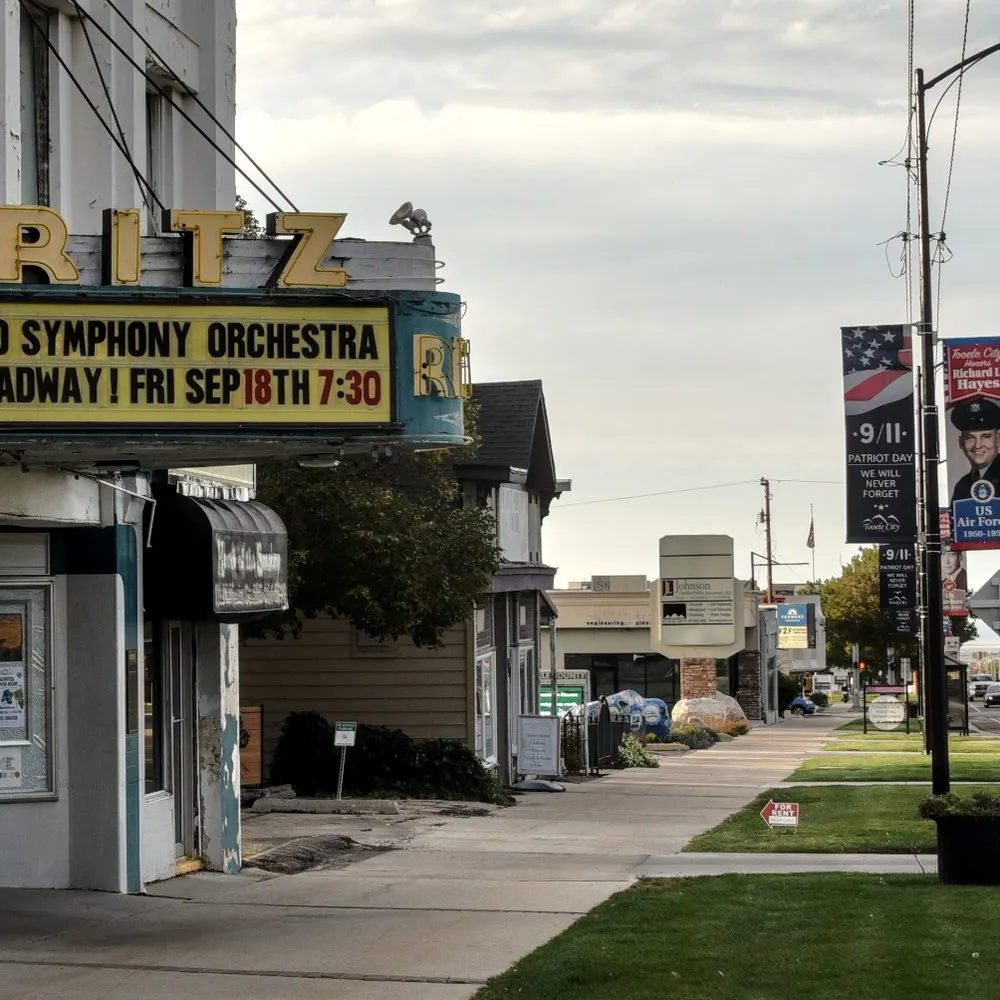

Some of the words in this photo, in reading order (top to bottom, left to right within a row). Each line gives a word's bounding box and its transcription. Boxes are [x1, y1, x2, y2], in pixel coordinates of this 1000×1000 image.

[21, 320, 190, 358] SYMPHONY
[207, 322, 379, 361] ORCHESTRA
[952, 348, 980, 359] Tooele
[952, 368, 992, 379] Richard
[130, 368, 174, 404] FRI
[318, 369, 381, 406] 7:30
[957, 379, 1000, 391] Hayes
[859, 422, 901, 444] 9/11
[848, 454, 890, 463] PATRIOT
[892, 453, 913, 462] DAY
[878, 469, 900, 477] WILL
[863, 490, 899, 498] FORGET
[975, 506, 993, 516] US
[957, 517, 975, 527] Air
[886, 549, 908, 560] 9/11
[675, 580, 711, 592] Johnson
